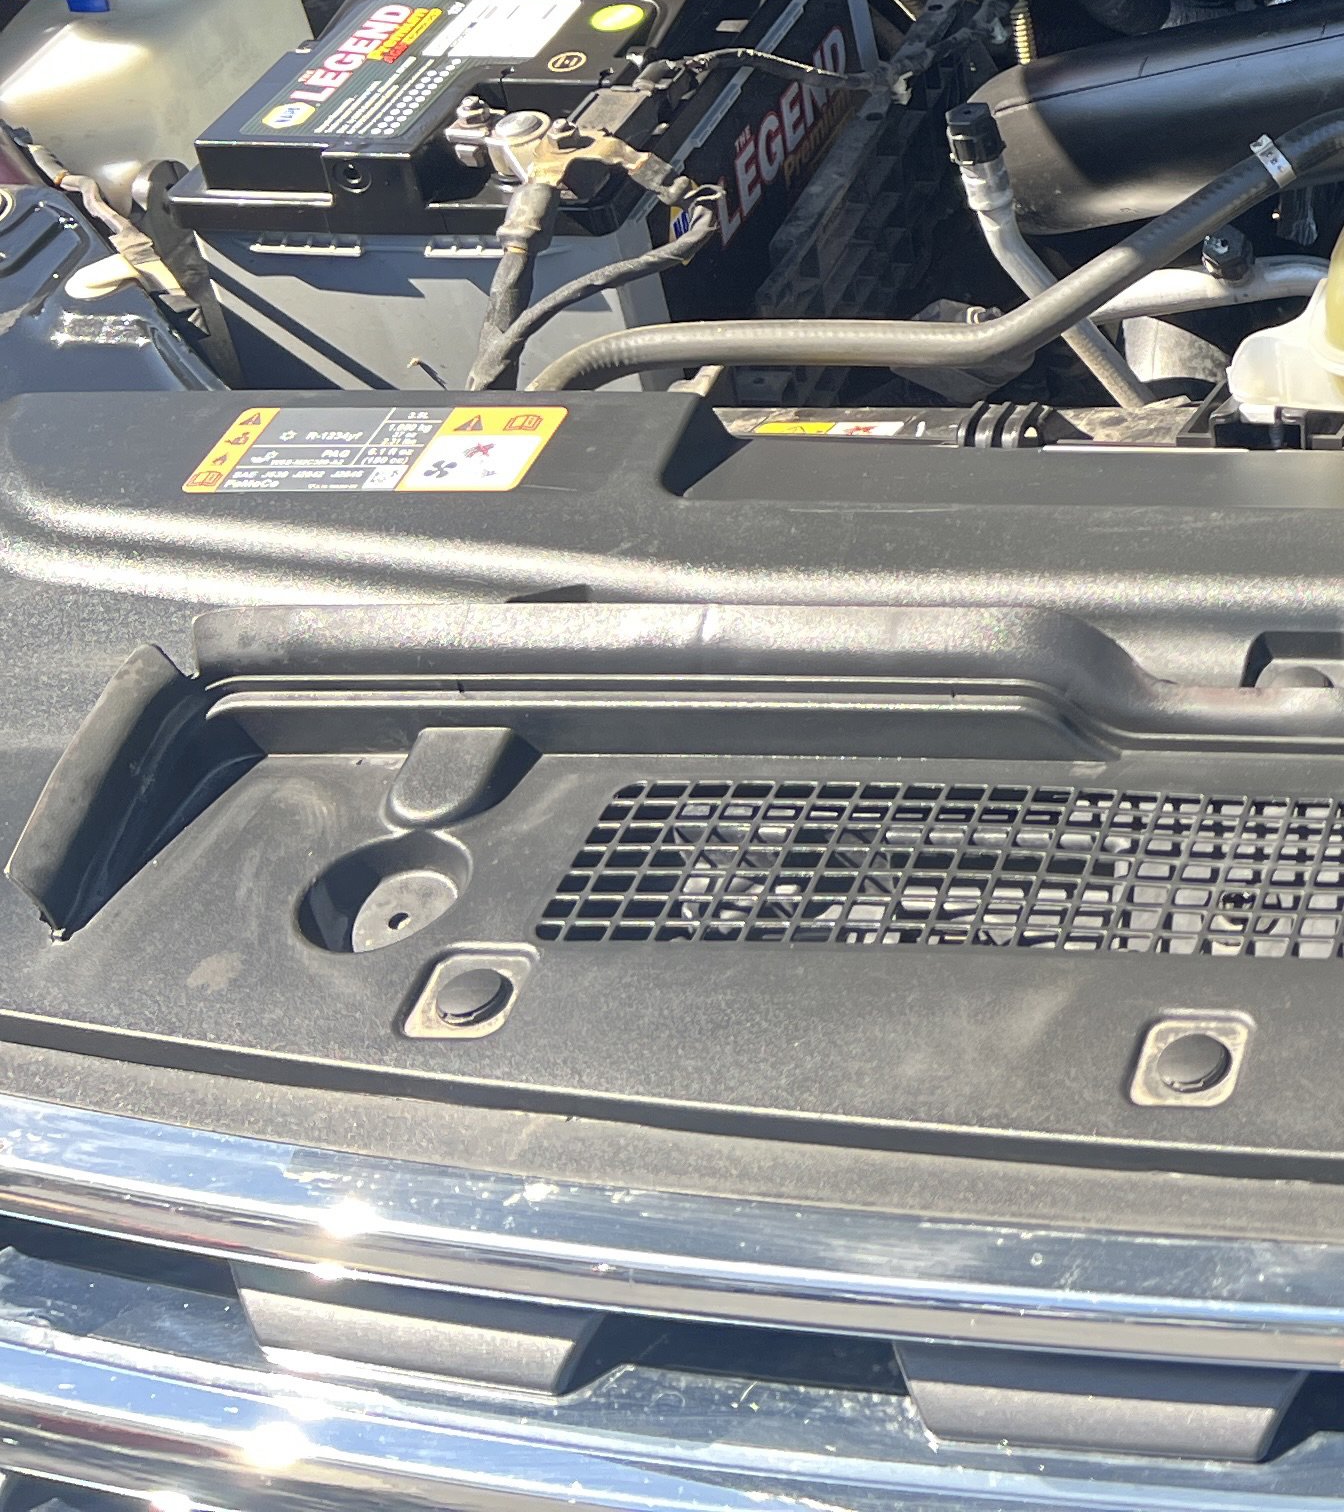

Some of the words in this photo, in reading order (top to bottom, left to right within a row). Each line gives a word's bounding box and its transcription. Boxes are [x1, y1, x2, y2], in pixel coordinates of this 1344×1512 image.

[290, 3, 416, 103] LEGEND
[716, 27, 847, 247] LEGEND
[734, 125, 752, 155] THE
[305, 431, 364, 442] R-1234yf
